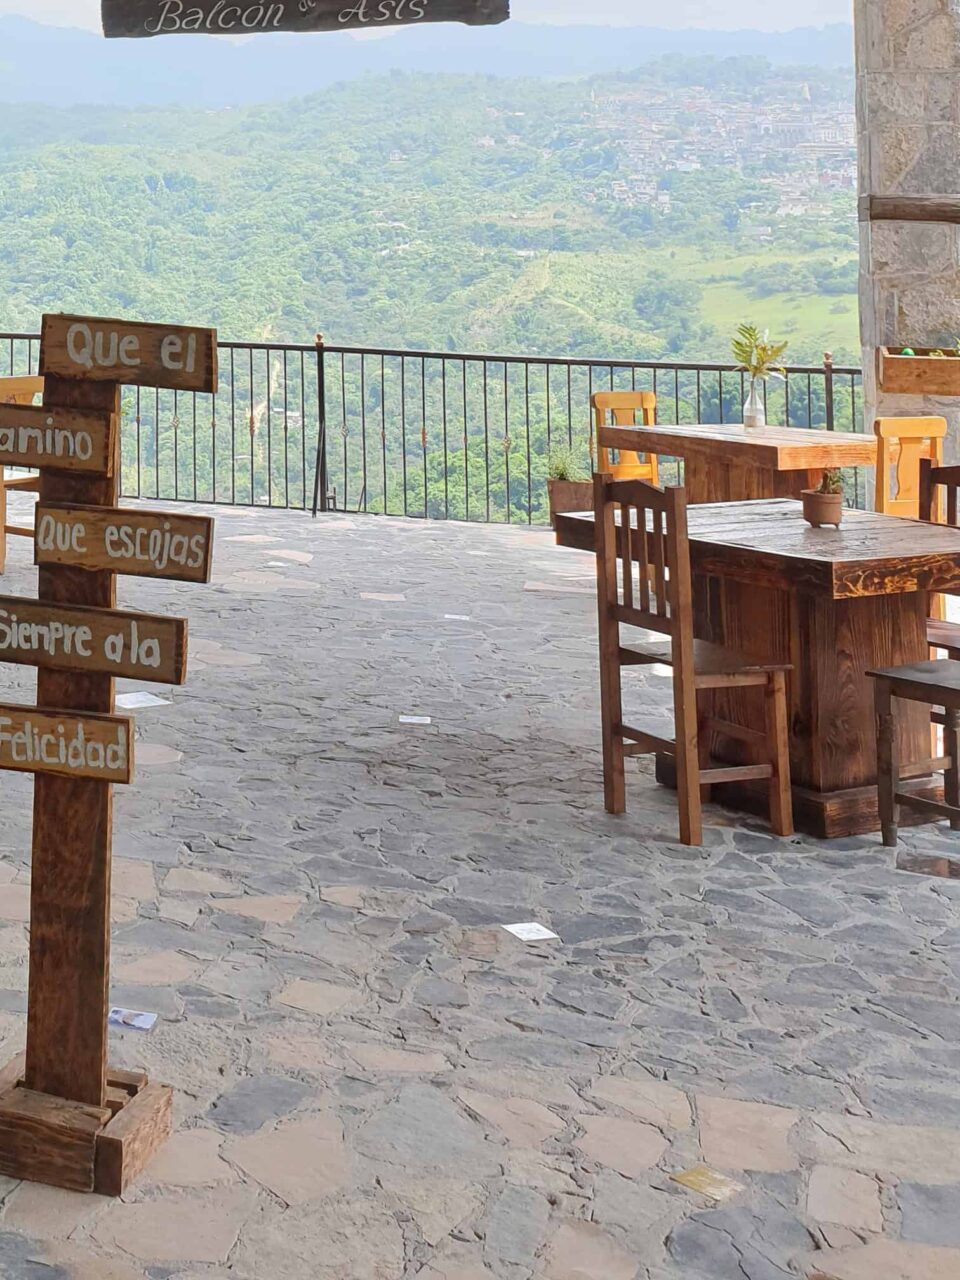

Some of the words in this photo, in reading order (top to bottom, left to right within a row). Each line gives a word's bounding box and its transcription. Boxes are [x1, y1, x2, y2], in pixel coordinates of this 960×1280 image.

[67, 323, 140, 368] Que
[161, 333, 196, 372] el
[38, 515, 87, 552] Que
[105, 522, 205, 569] escojas
